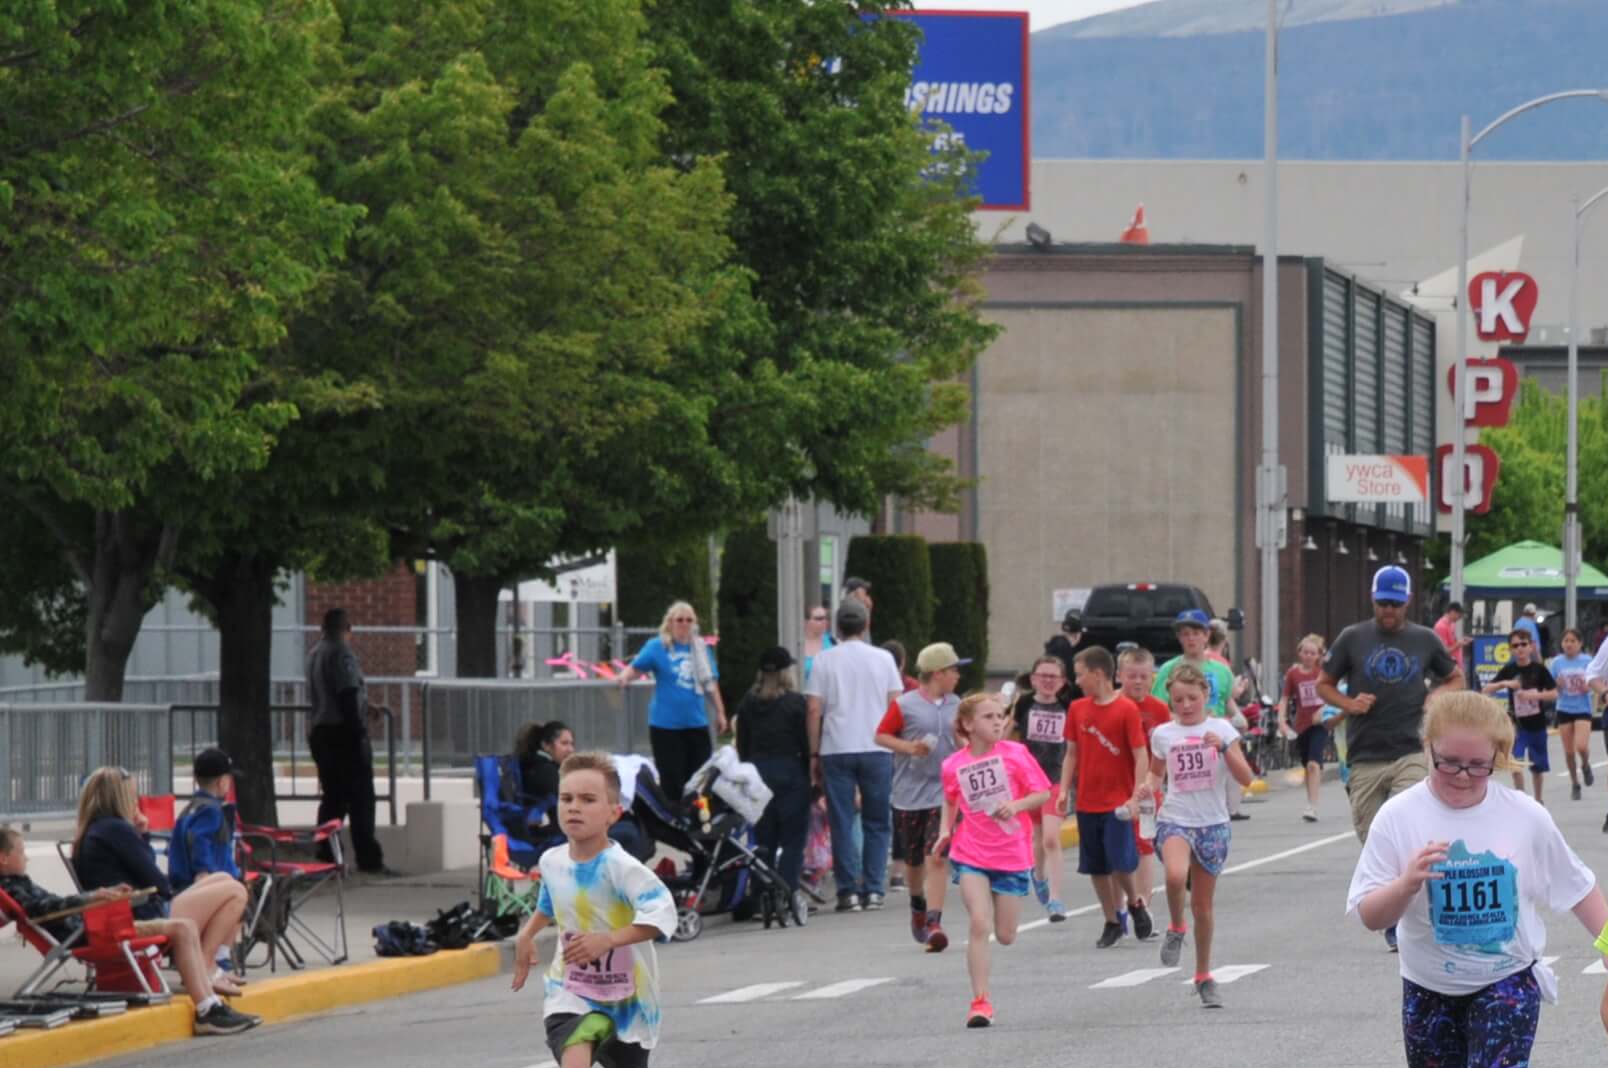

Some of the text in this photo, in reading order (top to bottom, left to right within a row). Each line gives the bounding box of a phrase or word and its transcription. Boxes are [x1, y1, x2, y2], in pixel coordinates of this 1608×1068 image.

[1346, 463, 1393, 481] ywca
[1357, 482, 1401, 496] Store
[1036, 720, 1056, 734] 671
[1177, 752, 1204, 771] 539
[969, 768, 996, 791] 673
[1441, 880, 1501, 912] 1161
[579, 949, 614, 973] 47
